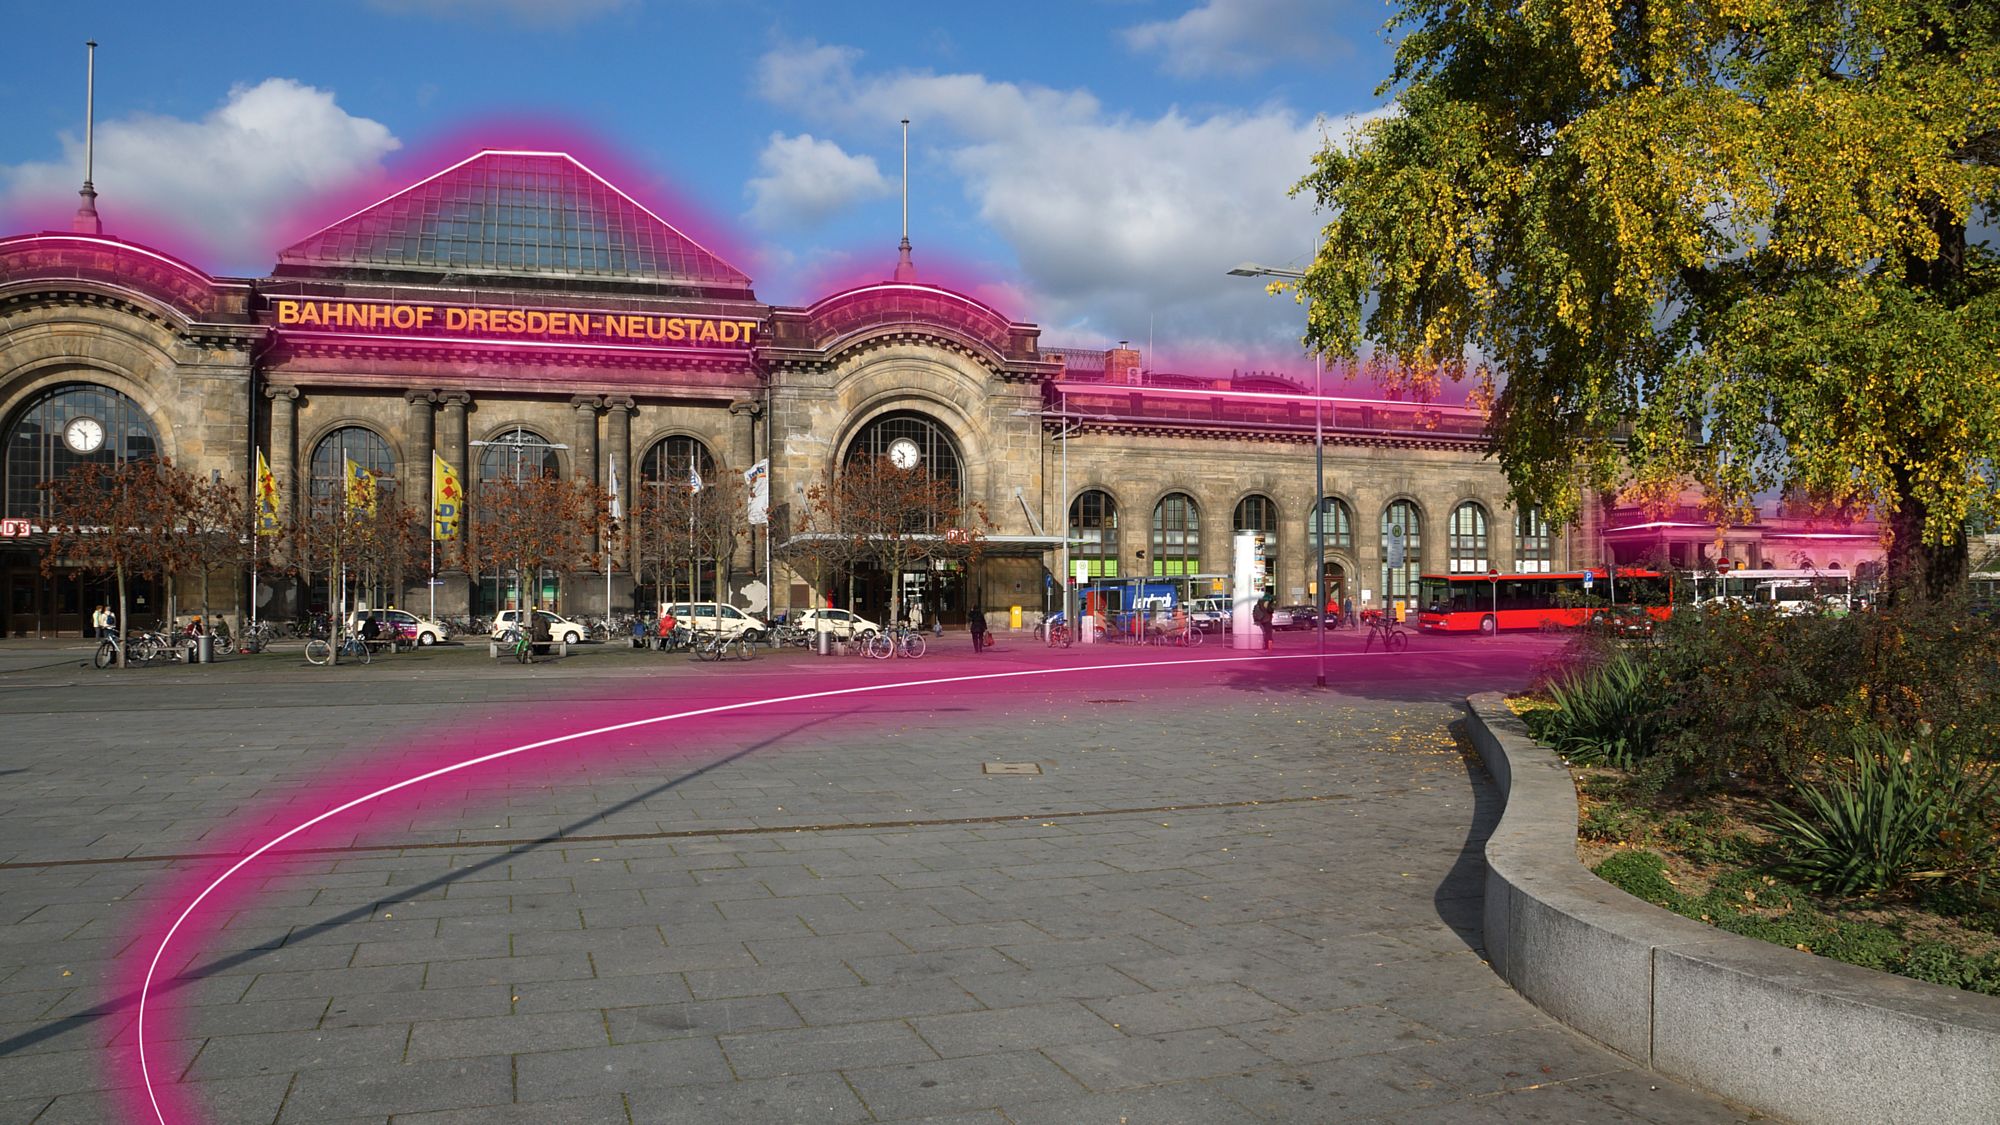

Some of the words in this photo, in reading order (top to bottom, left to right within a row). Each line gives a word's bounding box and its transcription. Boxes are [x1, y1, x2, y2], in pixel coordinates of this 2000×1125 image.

[279, 301, 434, 329] BAHNHOF
[446, 307, 757, 344] DRESDEN-NEUSTADT
[5, 521, 28, 534] DB
